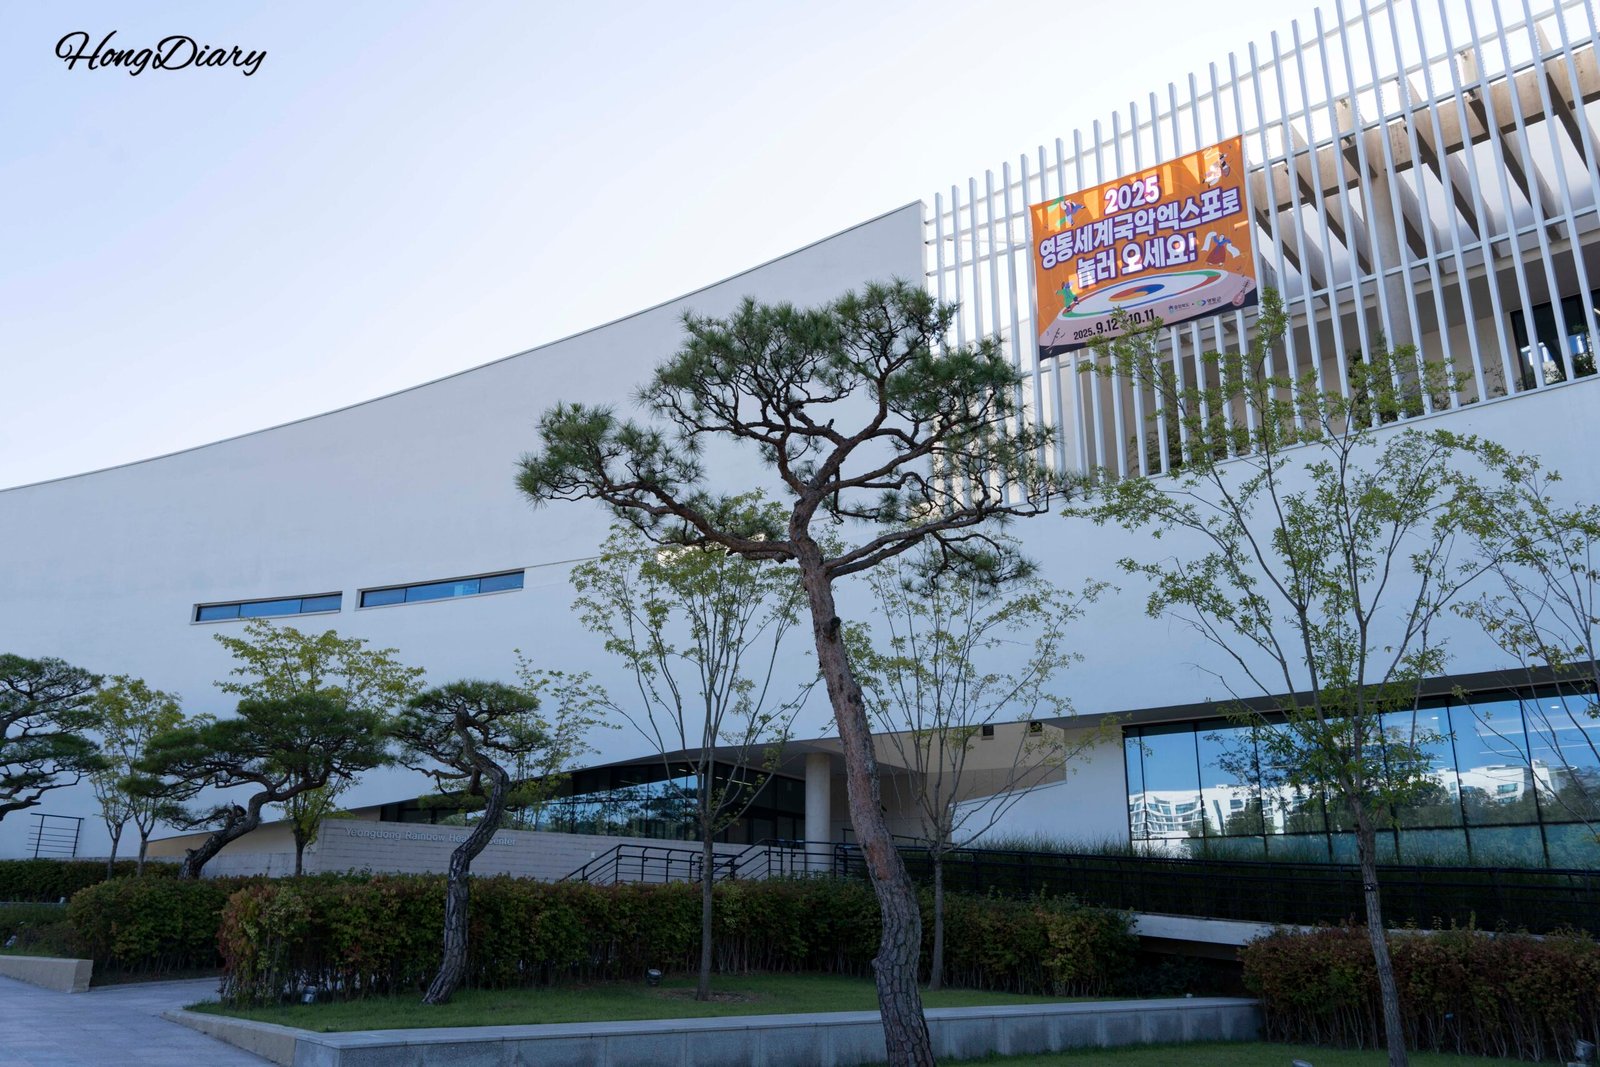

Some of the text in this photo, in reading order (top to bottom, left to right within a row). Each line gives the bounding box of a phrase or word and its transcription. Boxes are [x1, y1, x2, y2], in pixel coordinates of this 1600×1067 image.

[1104, 175, 1160, 215] 2025
[1040, 187, 1240, 269] 영동세계국악엑스포로
[1077, 233, 1197, 288] 놀러 오세요!
[344, 825, 402, 841] Yeongdong
[405, 830, 446, 842] Rainbow
